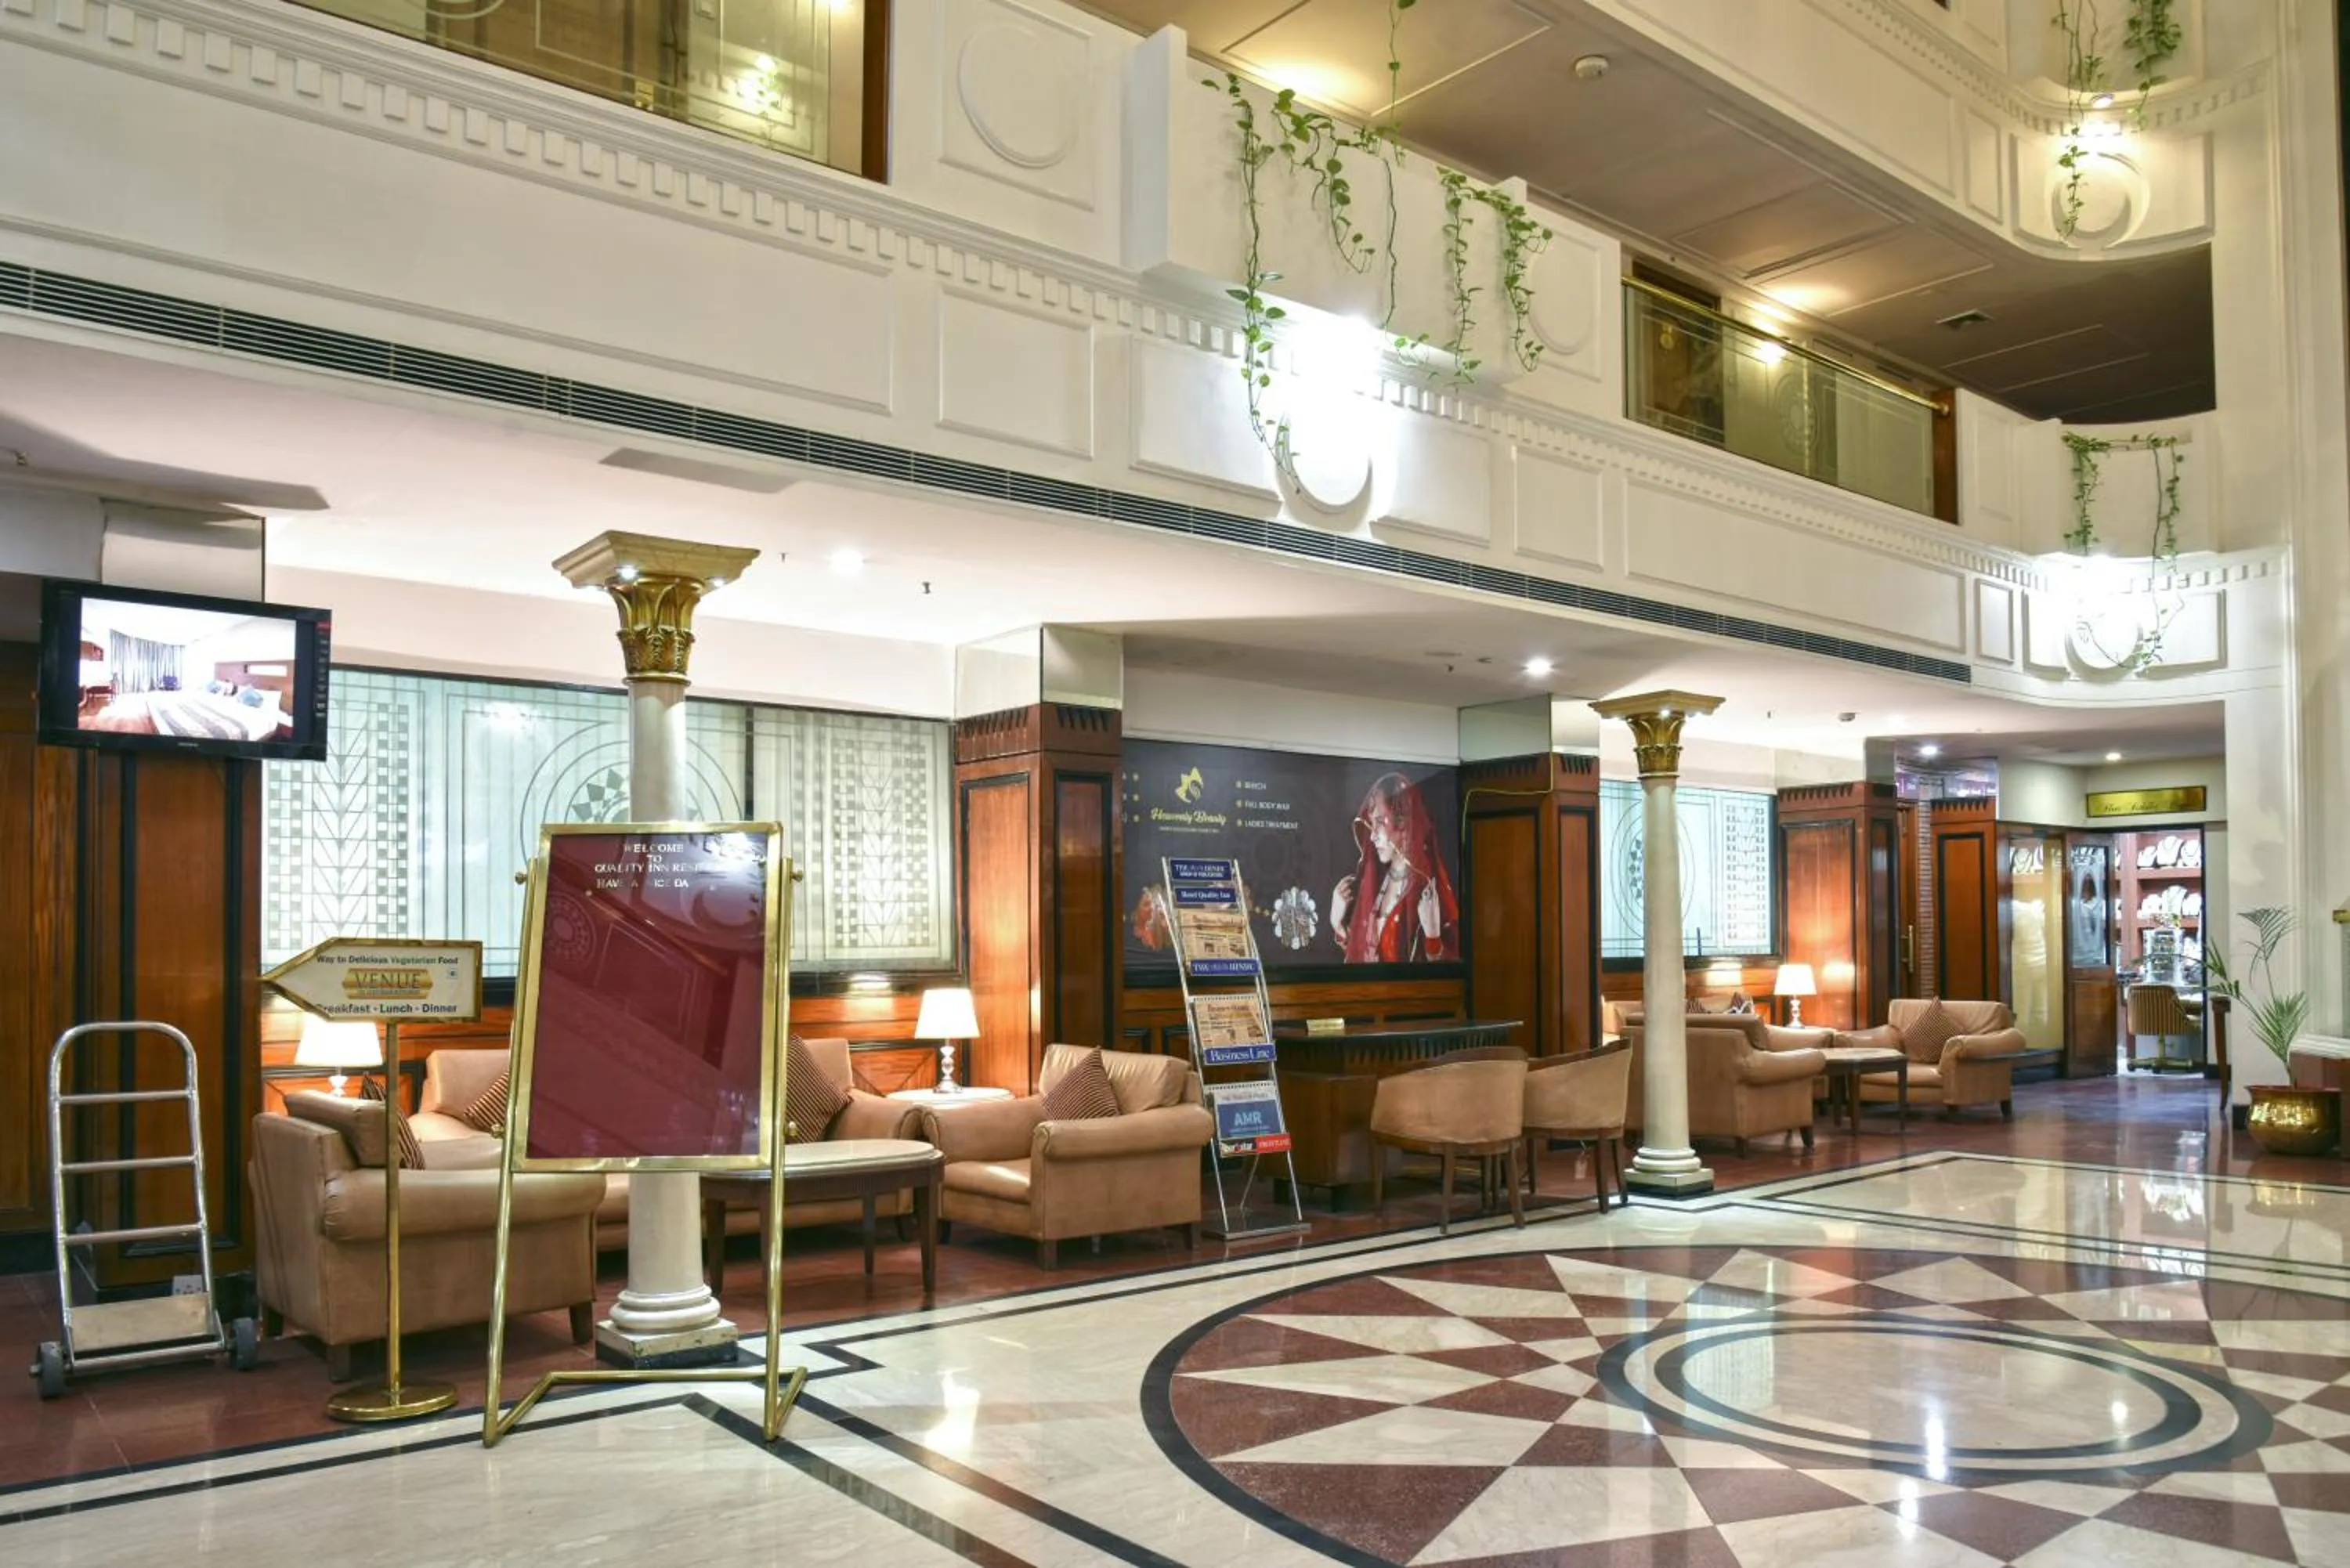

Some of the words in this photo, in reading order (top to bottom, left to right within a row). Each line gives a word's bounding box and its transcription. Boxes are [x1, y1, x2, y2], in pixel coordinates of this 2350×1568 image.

[595, 864, 644, 873] QUALITY
[316, 956, 335, 965] Way
[348, 956, 389, 964] Delicious
[390, 956, 437, 966] Vegetarian
[355, 972, 421, 989] VENUE
[380, 1003, 413, 1013] Lunch
[422, 1003, 457, 1013] Dinner
